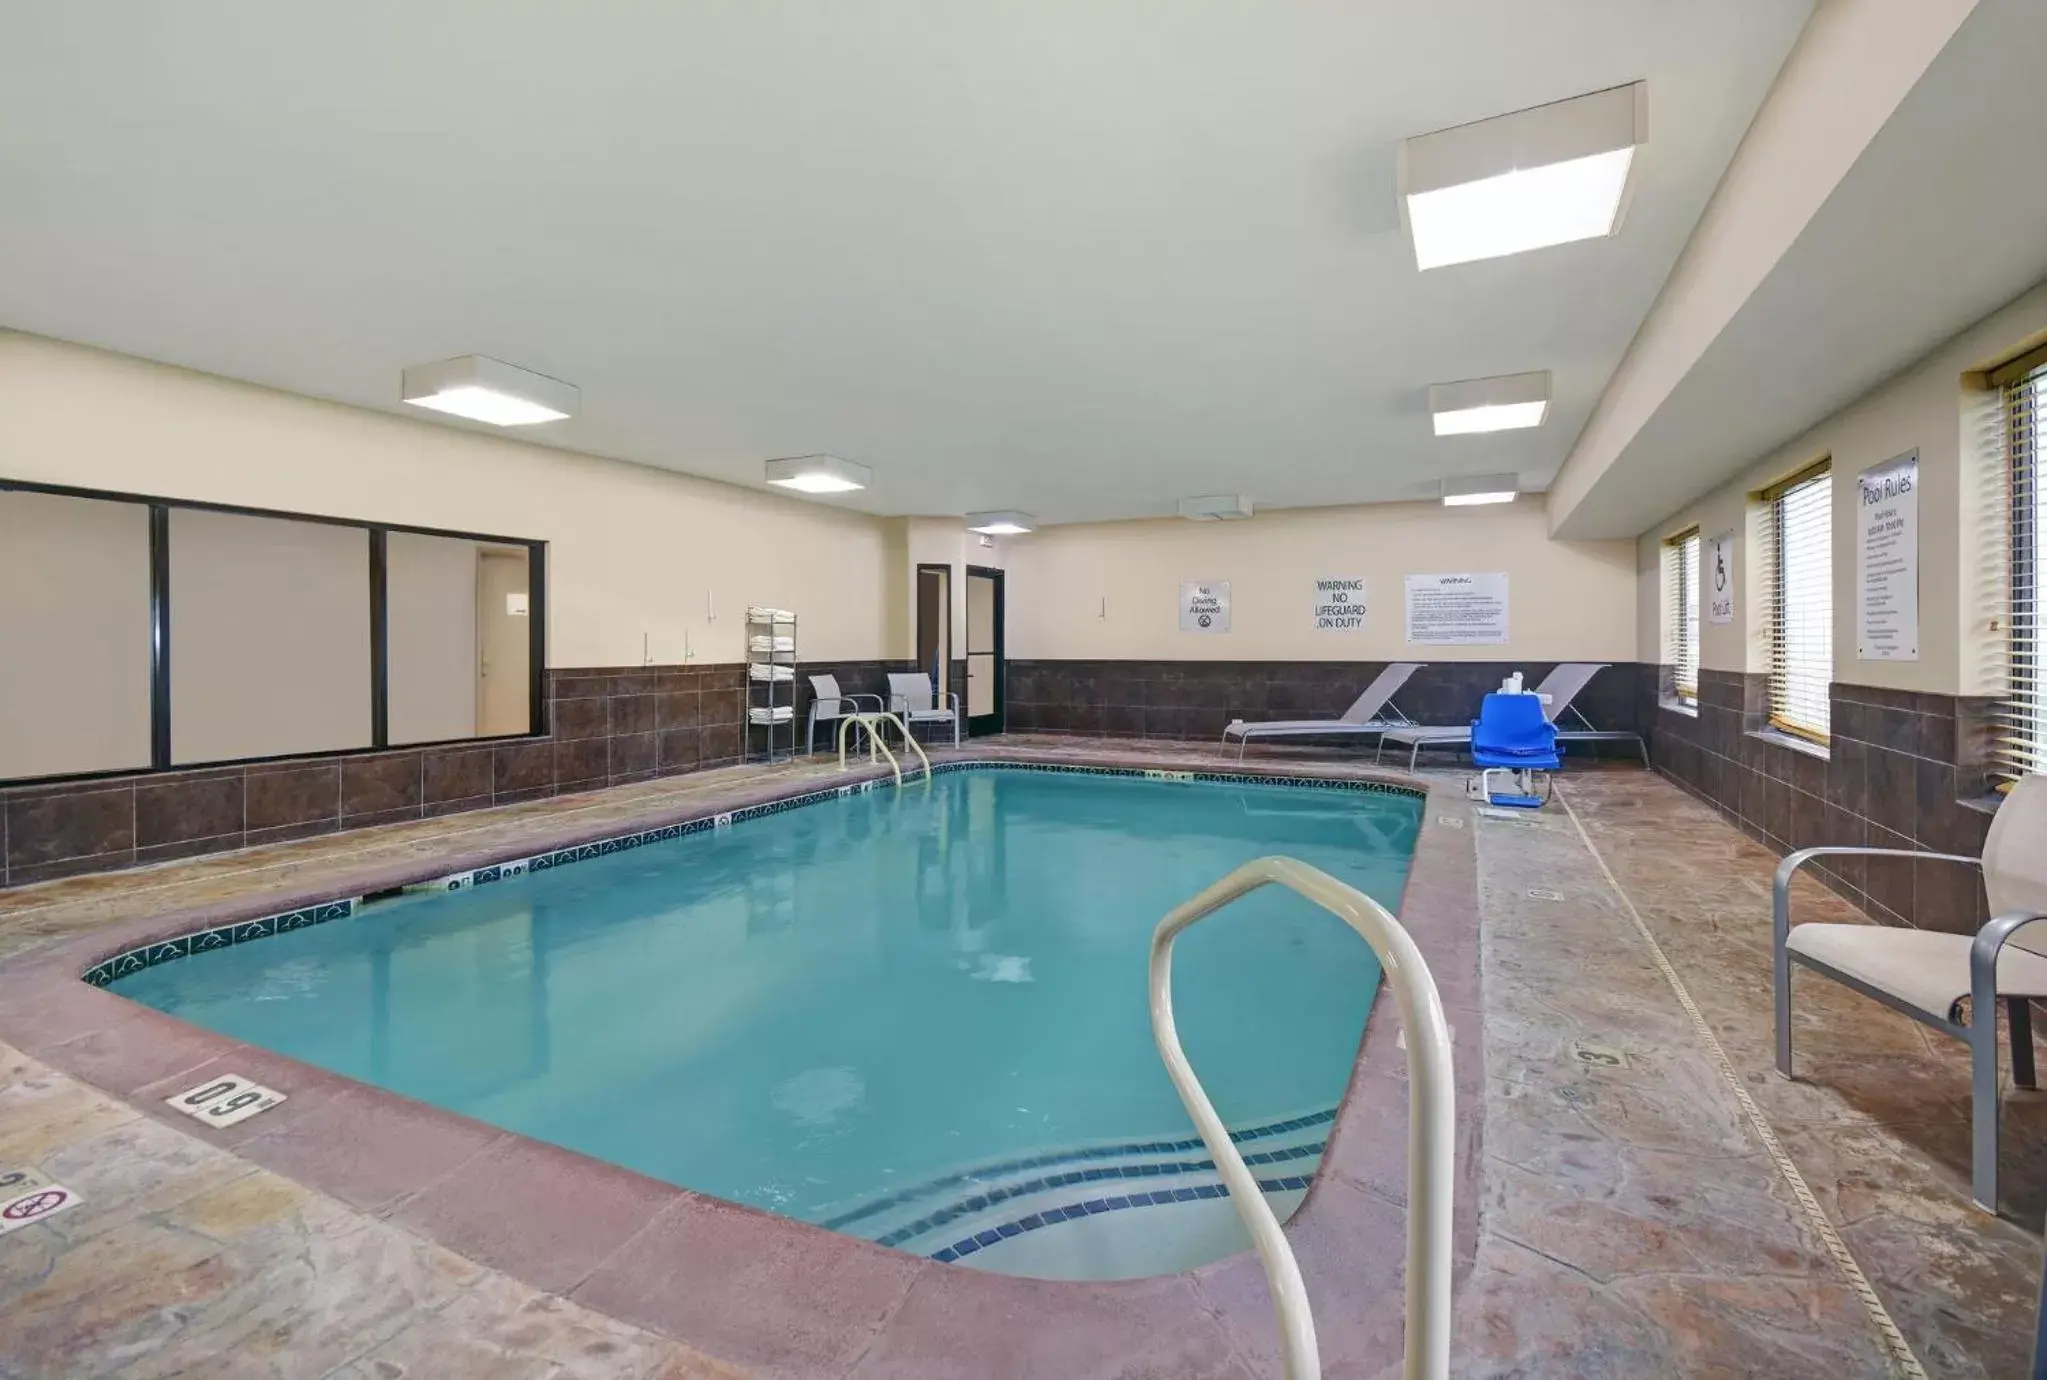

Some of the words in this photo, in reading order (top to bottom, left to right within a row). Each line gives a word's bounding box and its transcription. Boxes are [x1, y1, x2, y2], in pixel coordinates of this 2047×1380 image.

[1863, 480, 1883, 506] Pool
[1885, 474, 1912, 499] Rules
[1199, 586, 1210, 595] No
[1316, 579, 1363, 591] WARNING
[1332, 592, 1348, 603] NO
[1189, 605, 1221, 615] Allowed
[1314, 604, 1367, 617] LIFEGUARD
[1319, 617, 1333, 628] ON
[1335, 617, 1362, 629] DUTY
